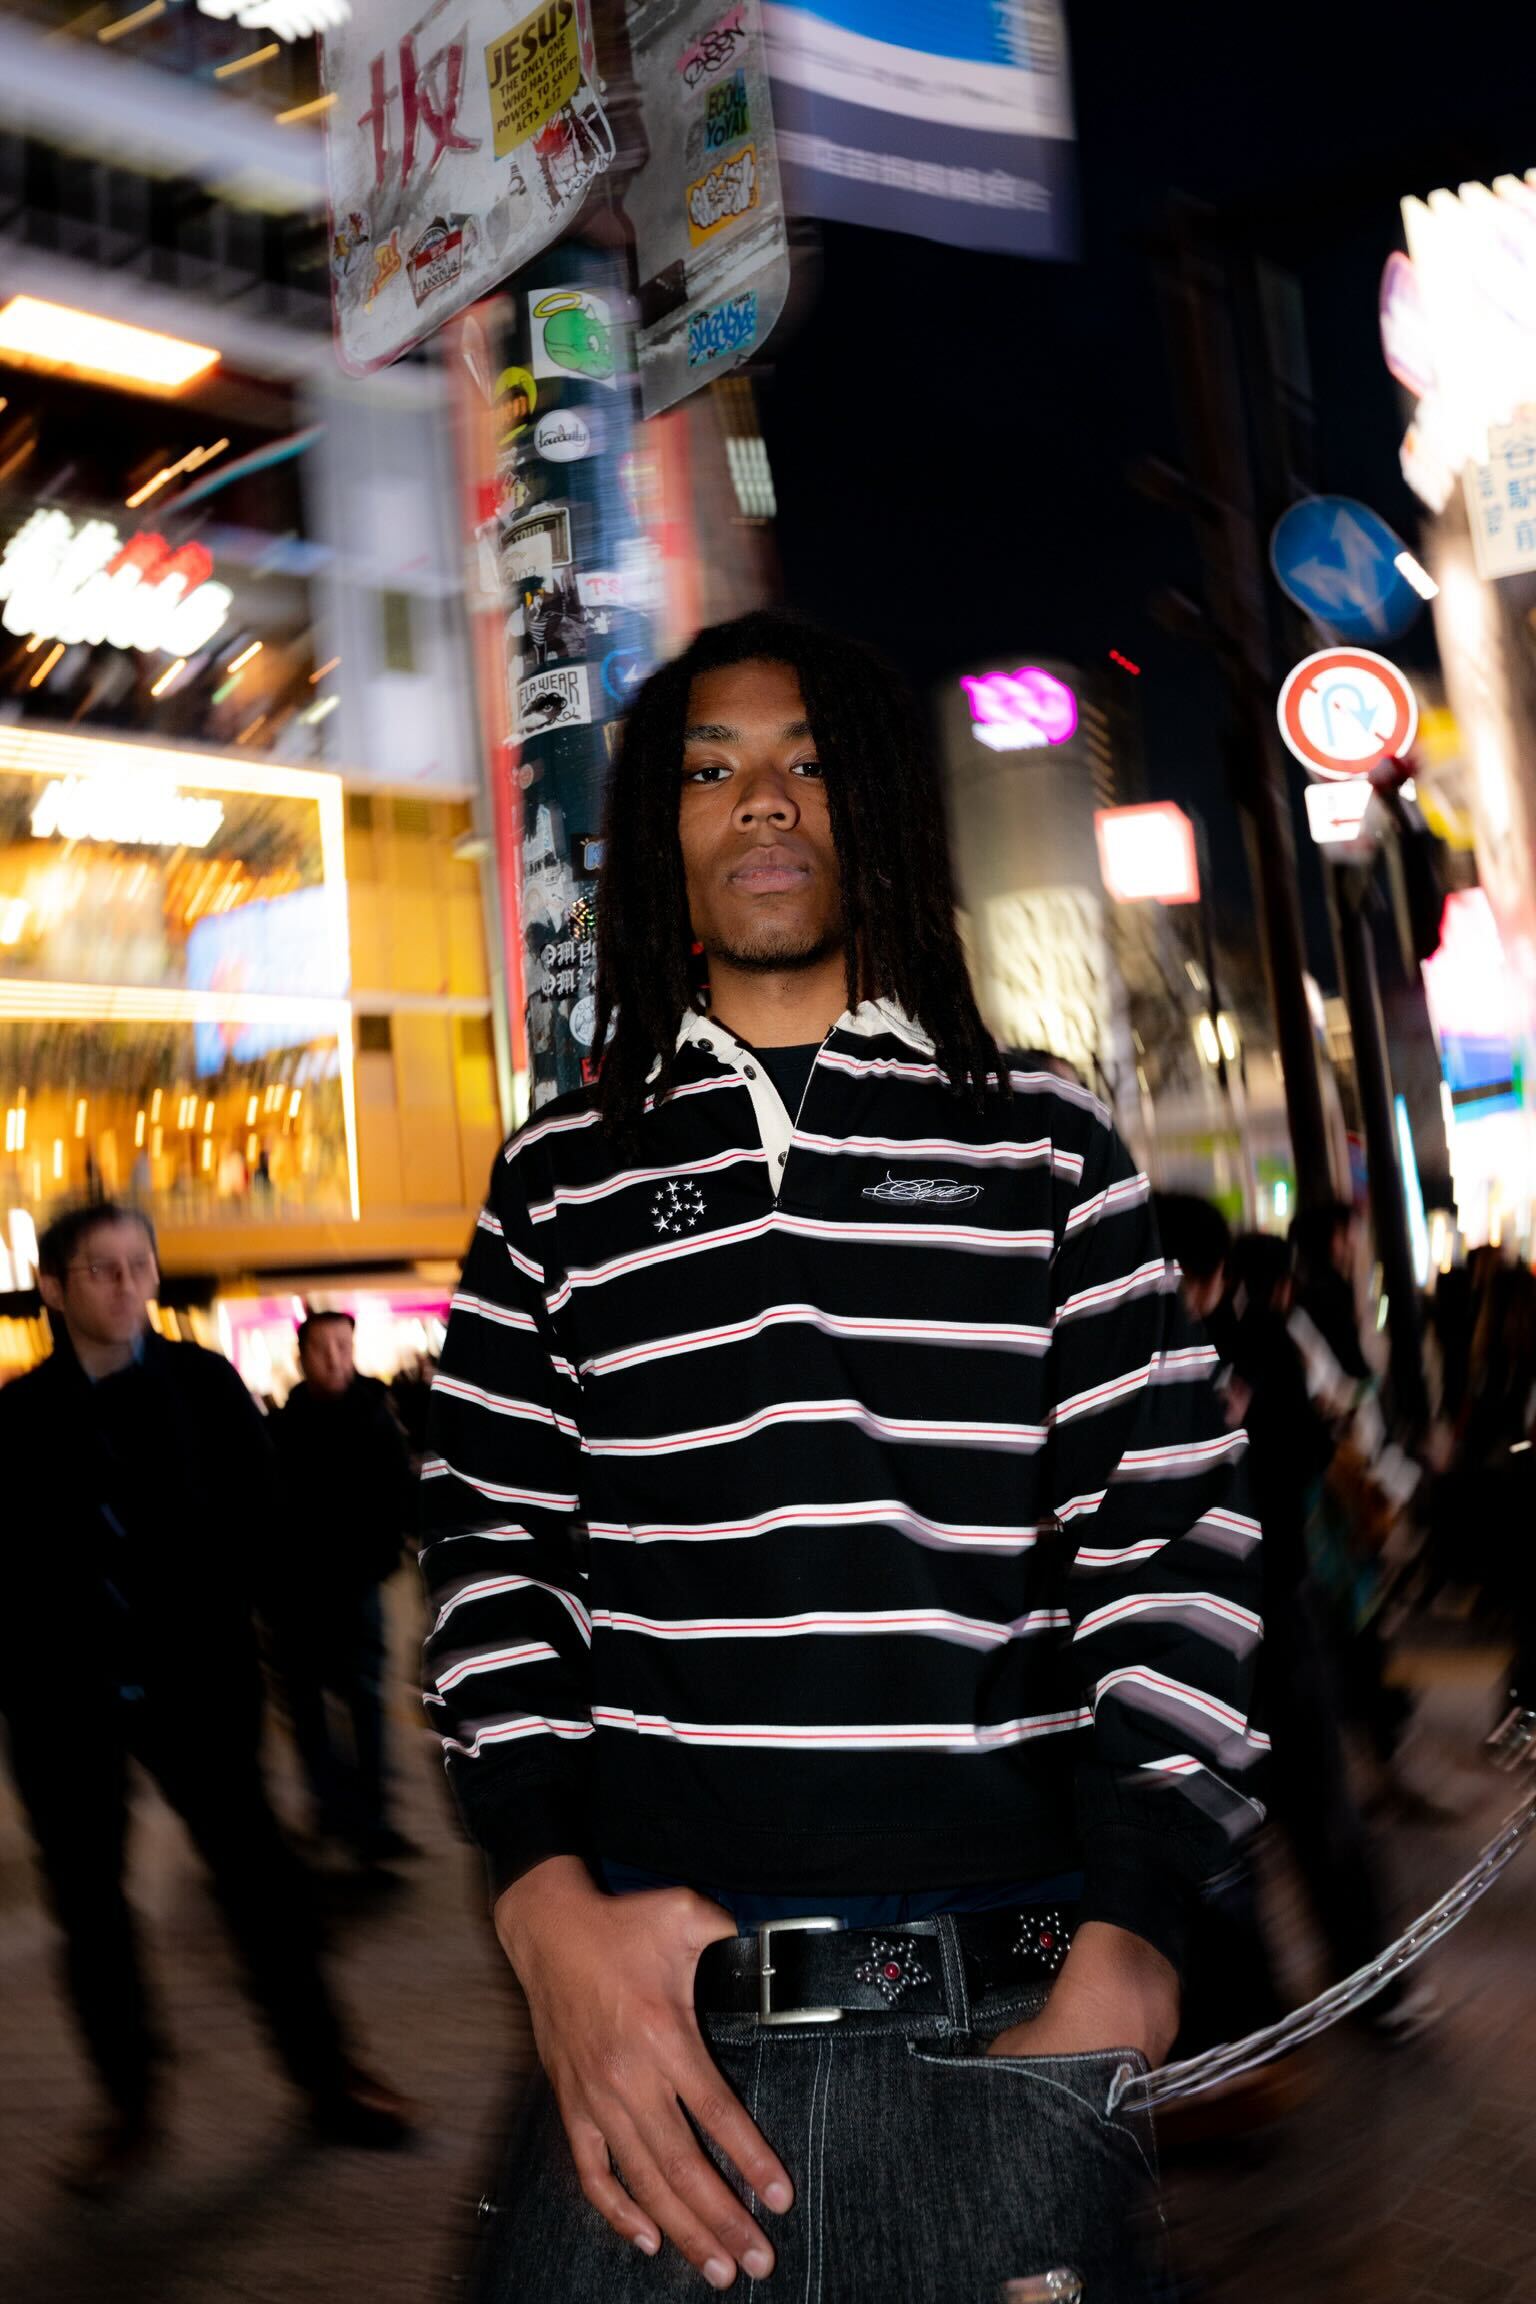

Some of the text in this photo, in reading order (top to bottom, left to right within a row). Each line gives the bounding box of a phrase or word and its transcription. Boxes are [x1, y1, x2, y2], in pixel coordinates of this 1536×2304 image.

[490, 0, 573, 88] JESUS
[500, 33, 565, 98] THE ONLY ONE
[497, 98, 532, 132] POWER
[537, 80, 550, 100] TO
[502, 51, 568, 112] WHO HAS THE
[516, 87, 561, 135] ACTS 4:12
